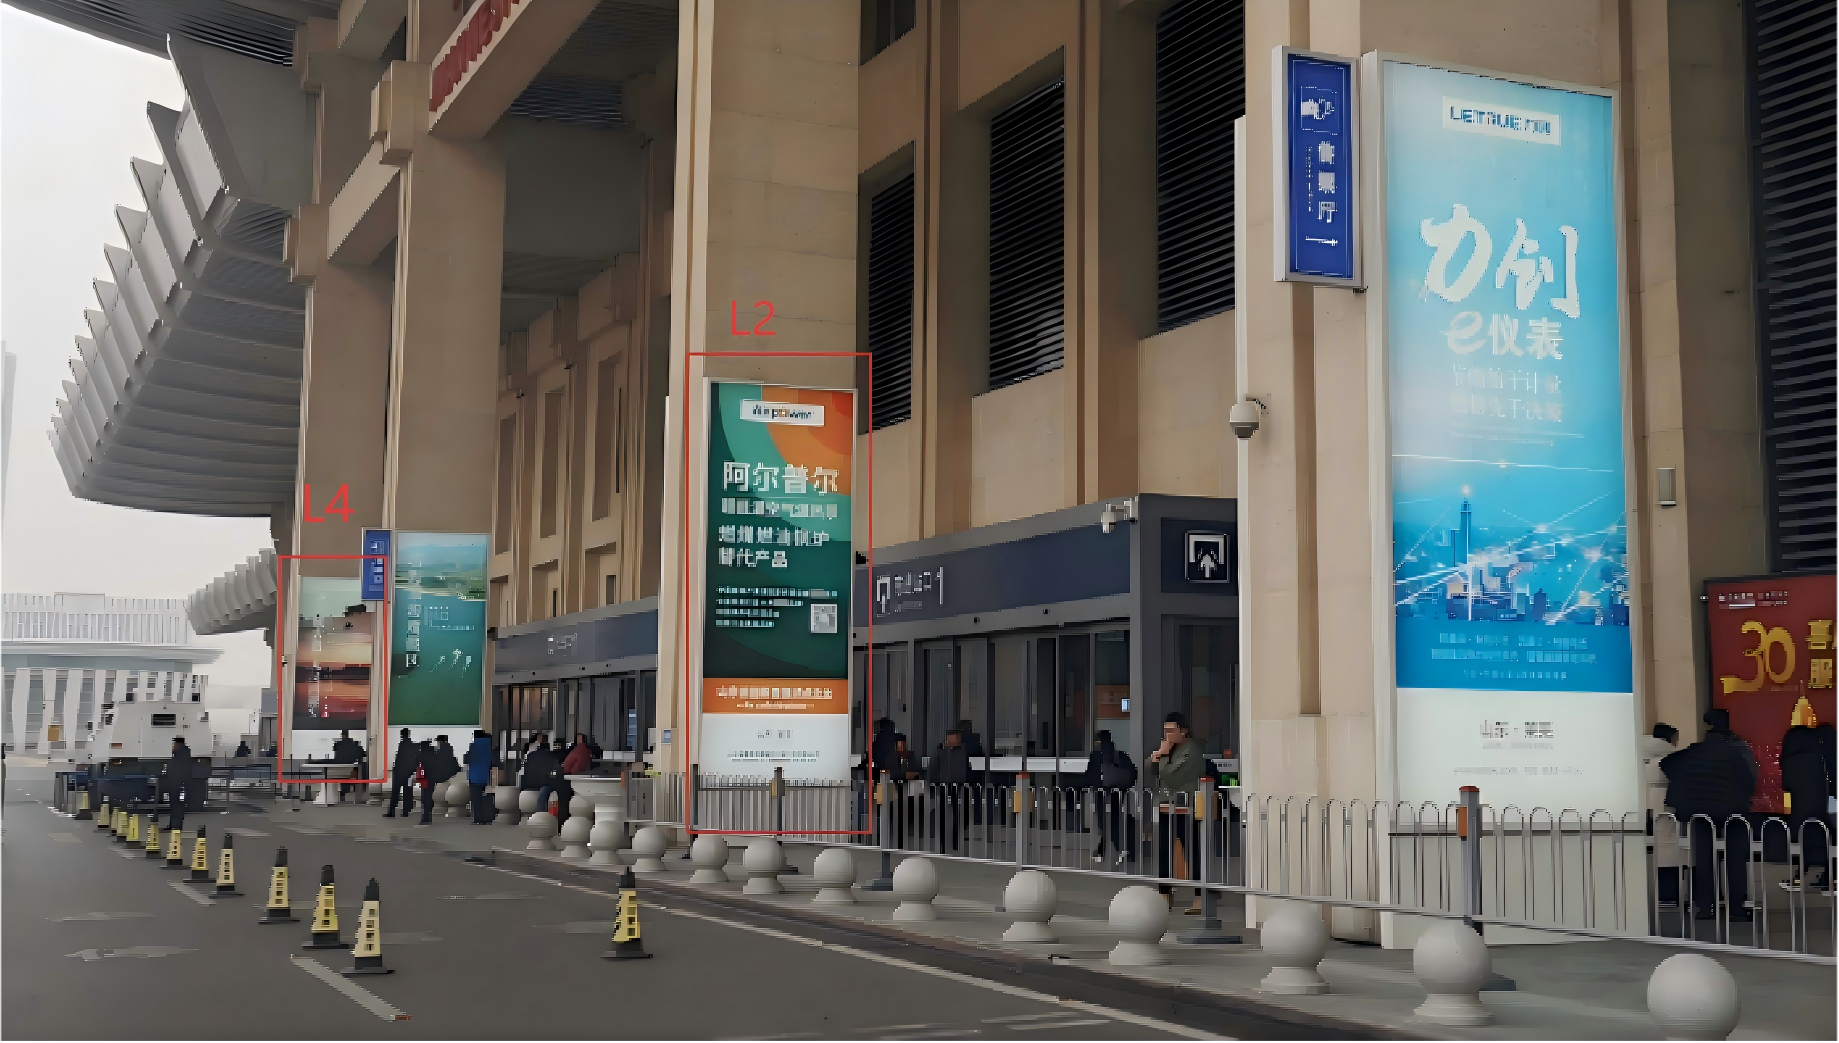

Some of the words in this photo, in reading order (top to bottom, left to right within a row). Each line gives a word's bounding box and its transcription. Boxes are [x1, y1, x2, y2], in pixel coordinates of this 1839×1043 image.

[1419, 203, 1581, 319] 力创
[1440, 310, 1564, 360] e仪表
[723, 460, 840, 496] 阿尔普尔
